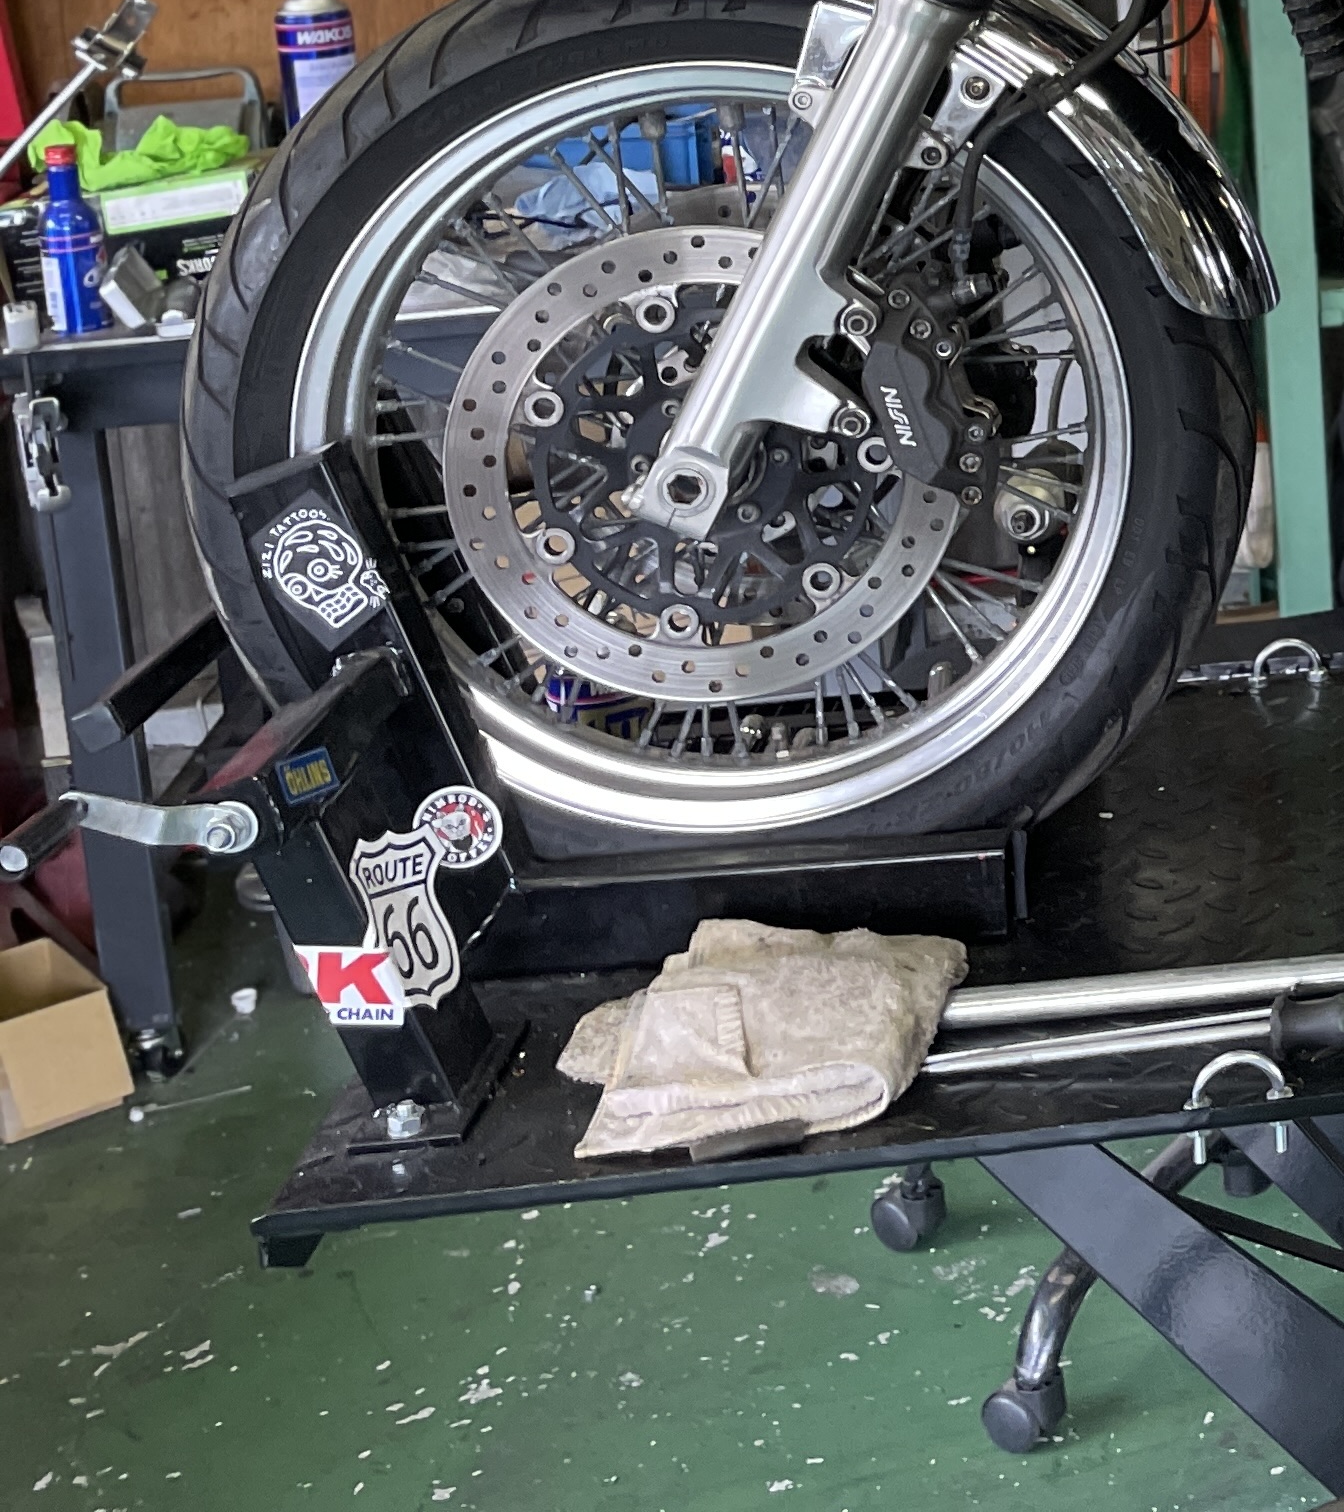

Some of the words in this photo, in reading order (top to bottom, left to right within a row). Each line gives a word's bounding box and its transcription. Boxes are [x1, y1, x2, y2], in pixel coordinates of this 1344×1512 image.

[879, 385, 918, 448] NISSIN
[362, 853, 426, 890] ROUTE
[382, 895, 440, 980] 66
[336, 1007, 394, 1021] CHAIN
